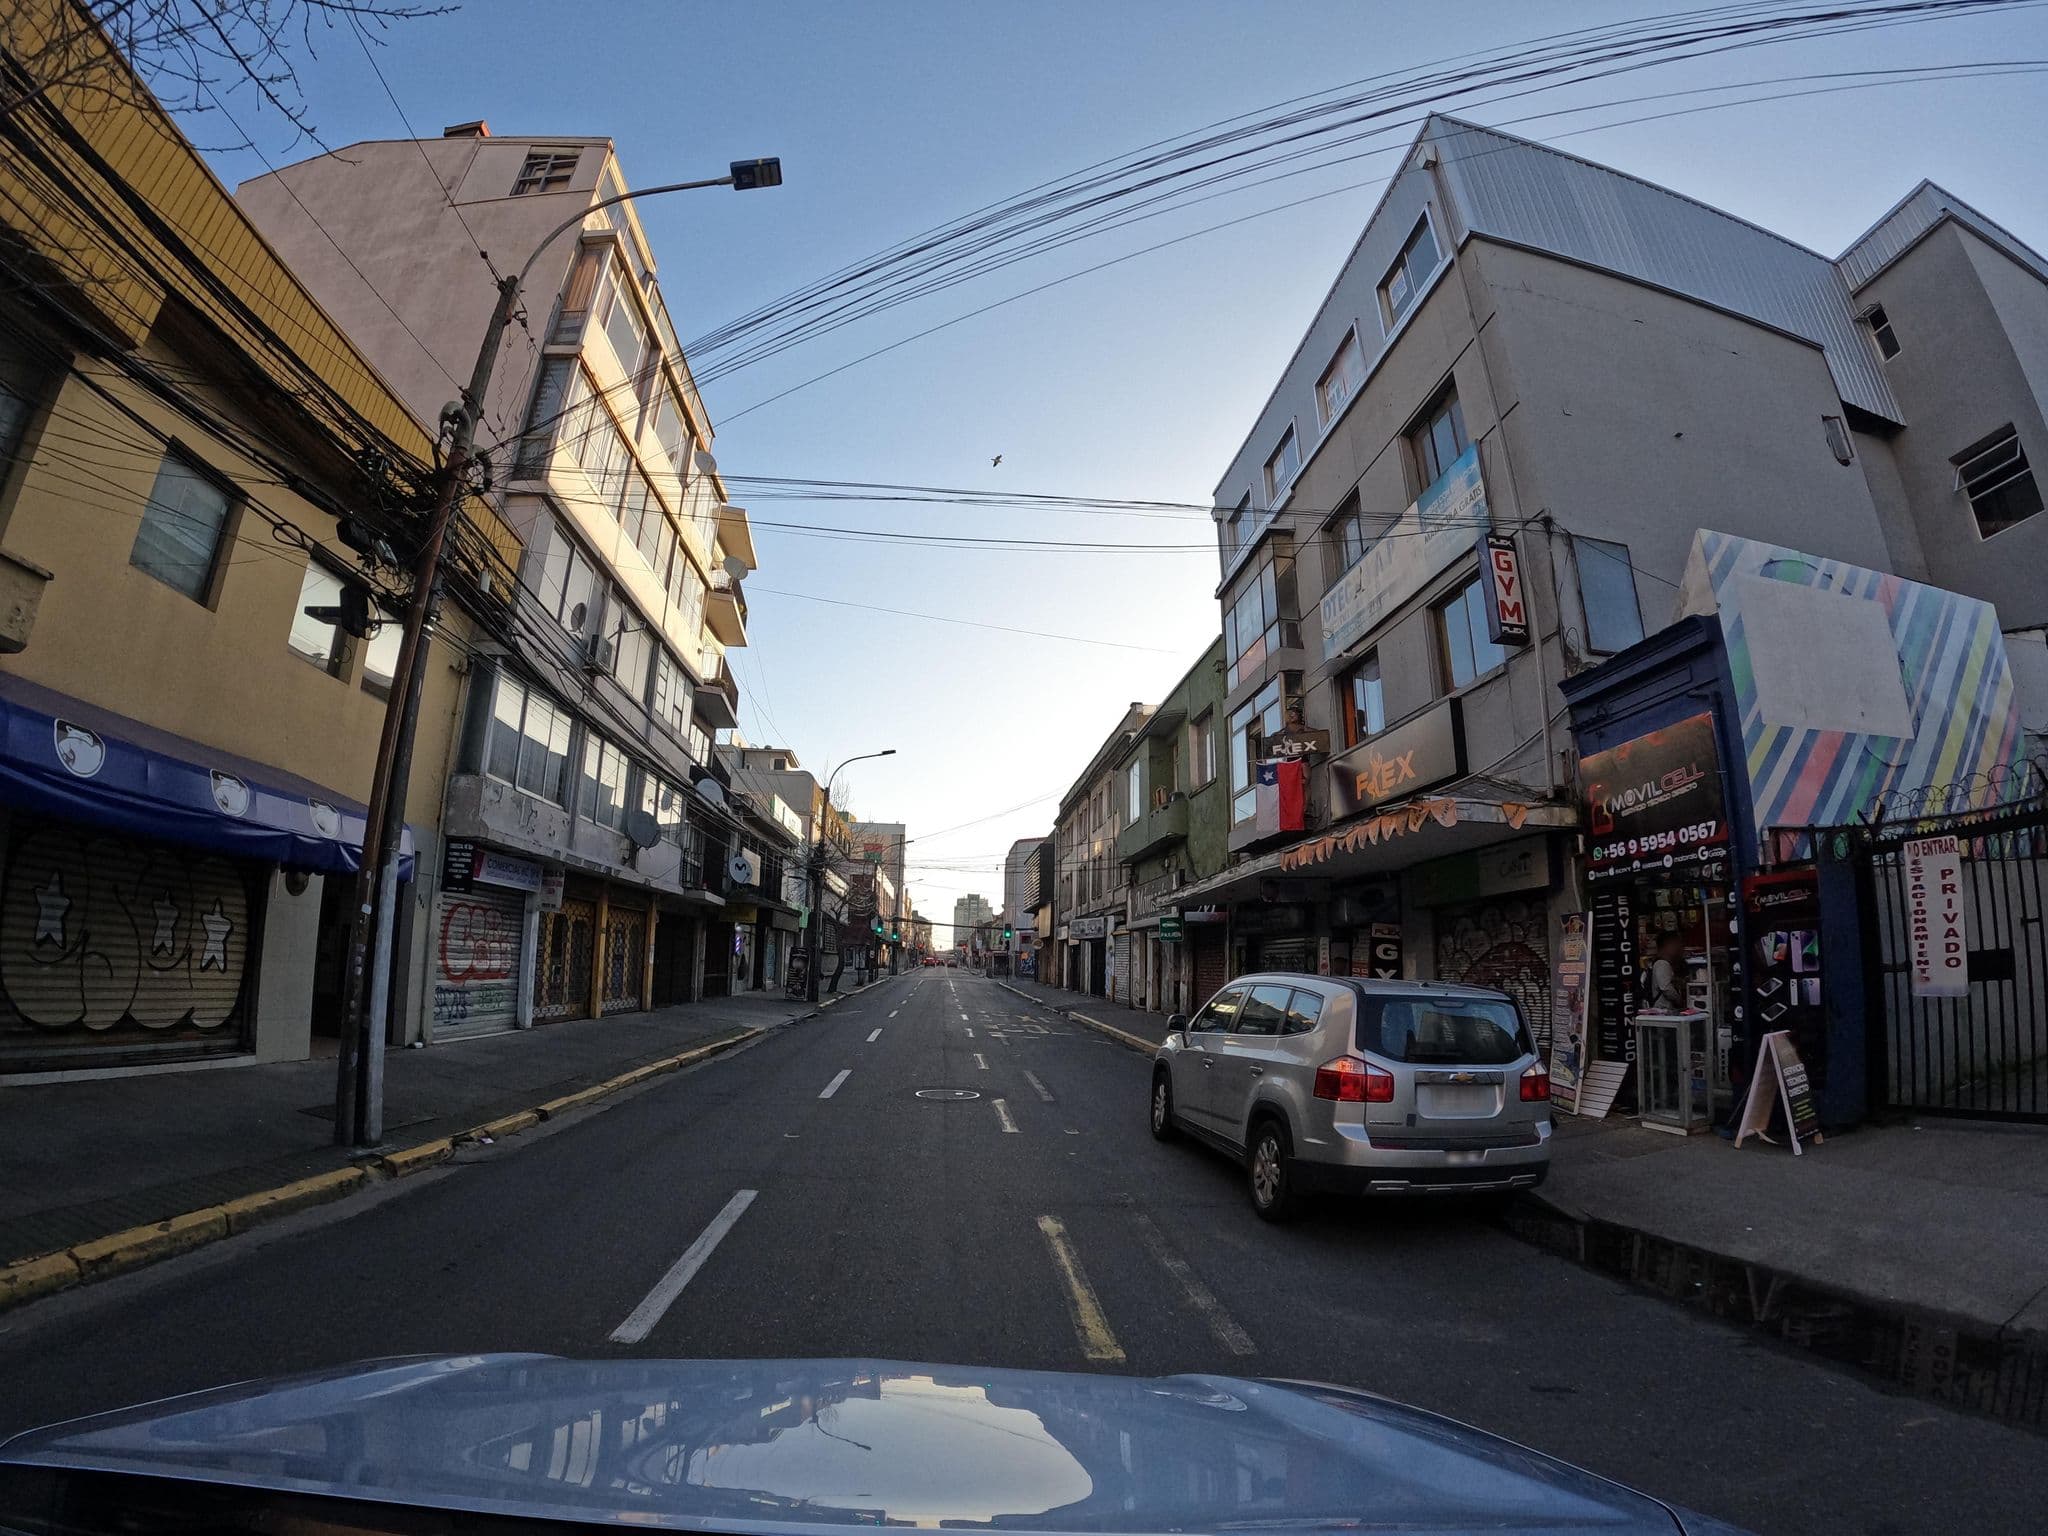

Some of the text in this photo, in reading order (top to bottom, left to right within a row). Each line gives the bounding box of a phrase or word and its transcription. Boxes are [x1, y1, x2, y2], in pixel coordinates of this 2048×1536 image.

[1494, 550, 1523, 623] GYM
[1611, 762, 1705, 813] MOVILCELL
[1603, 820, 1716, 859] +56 9 5954 0567
[1921, 837, 1960, 857] ENTRAR
[1940, 868, 1962, 968] PRIVADO
